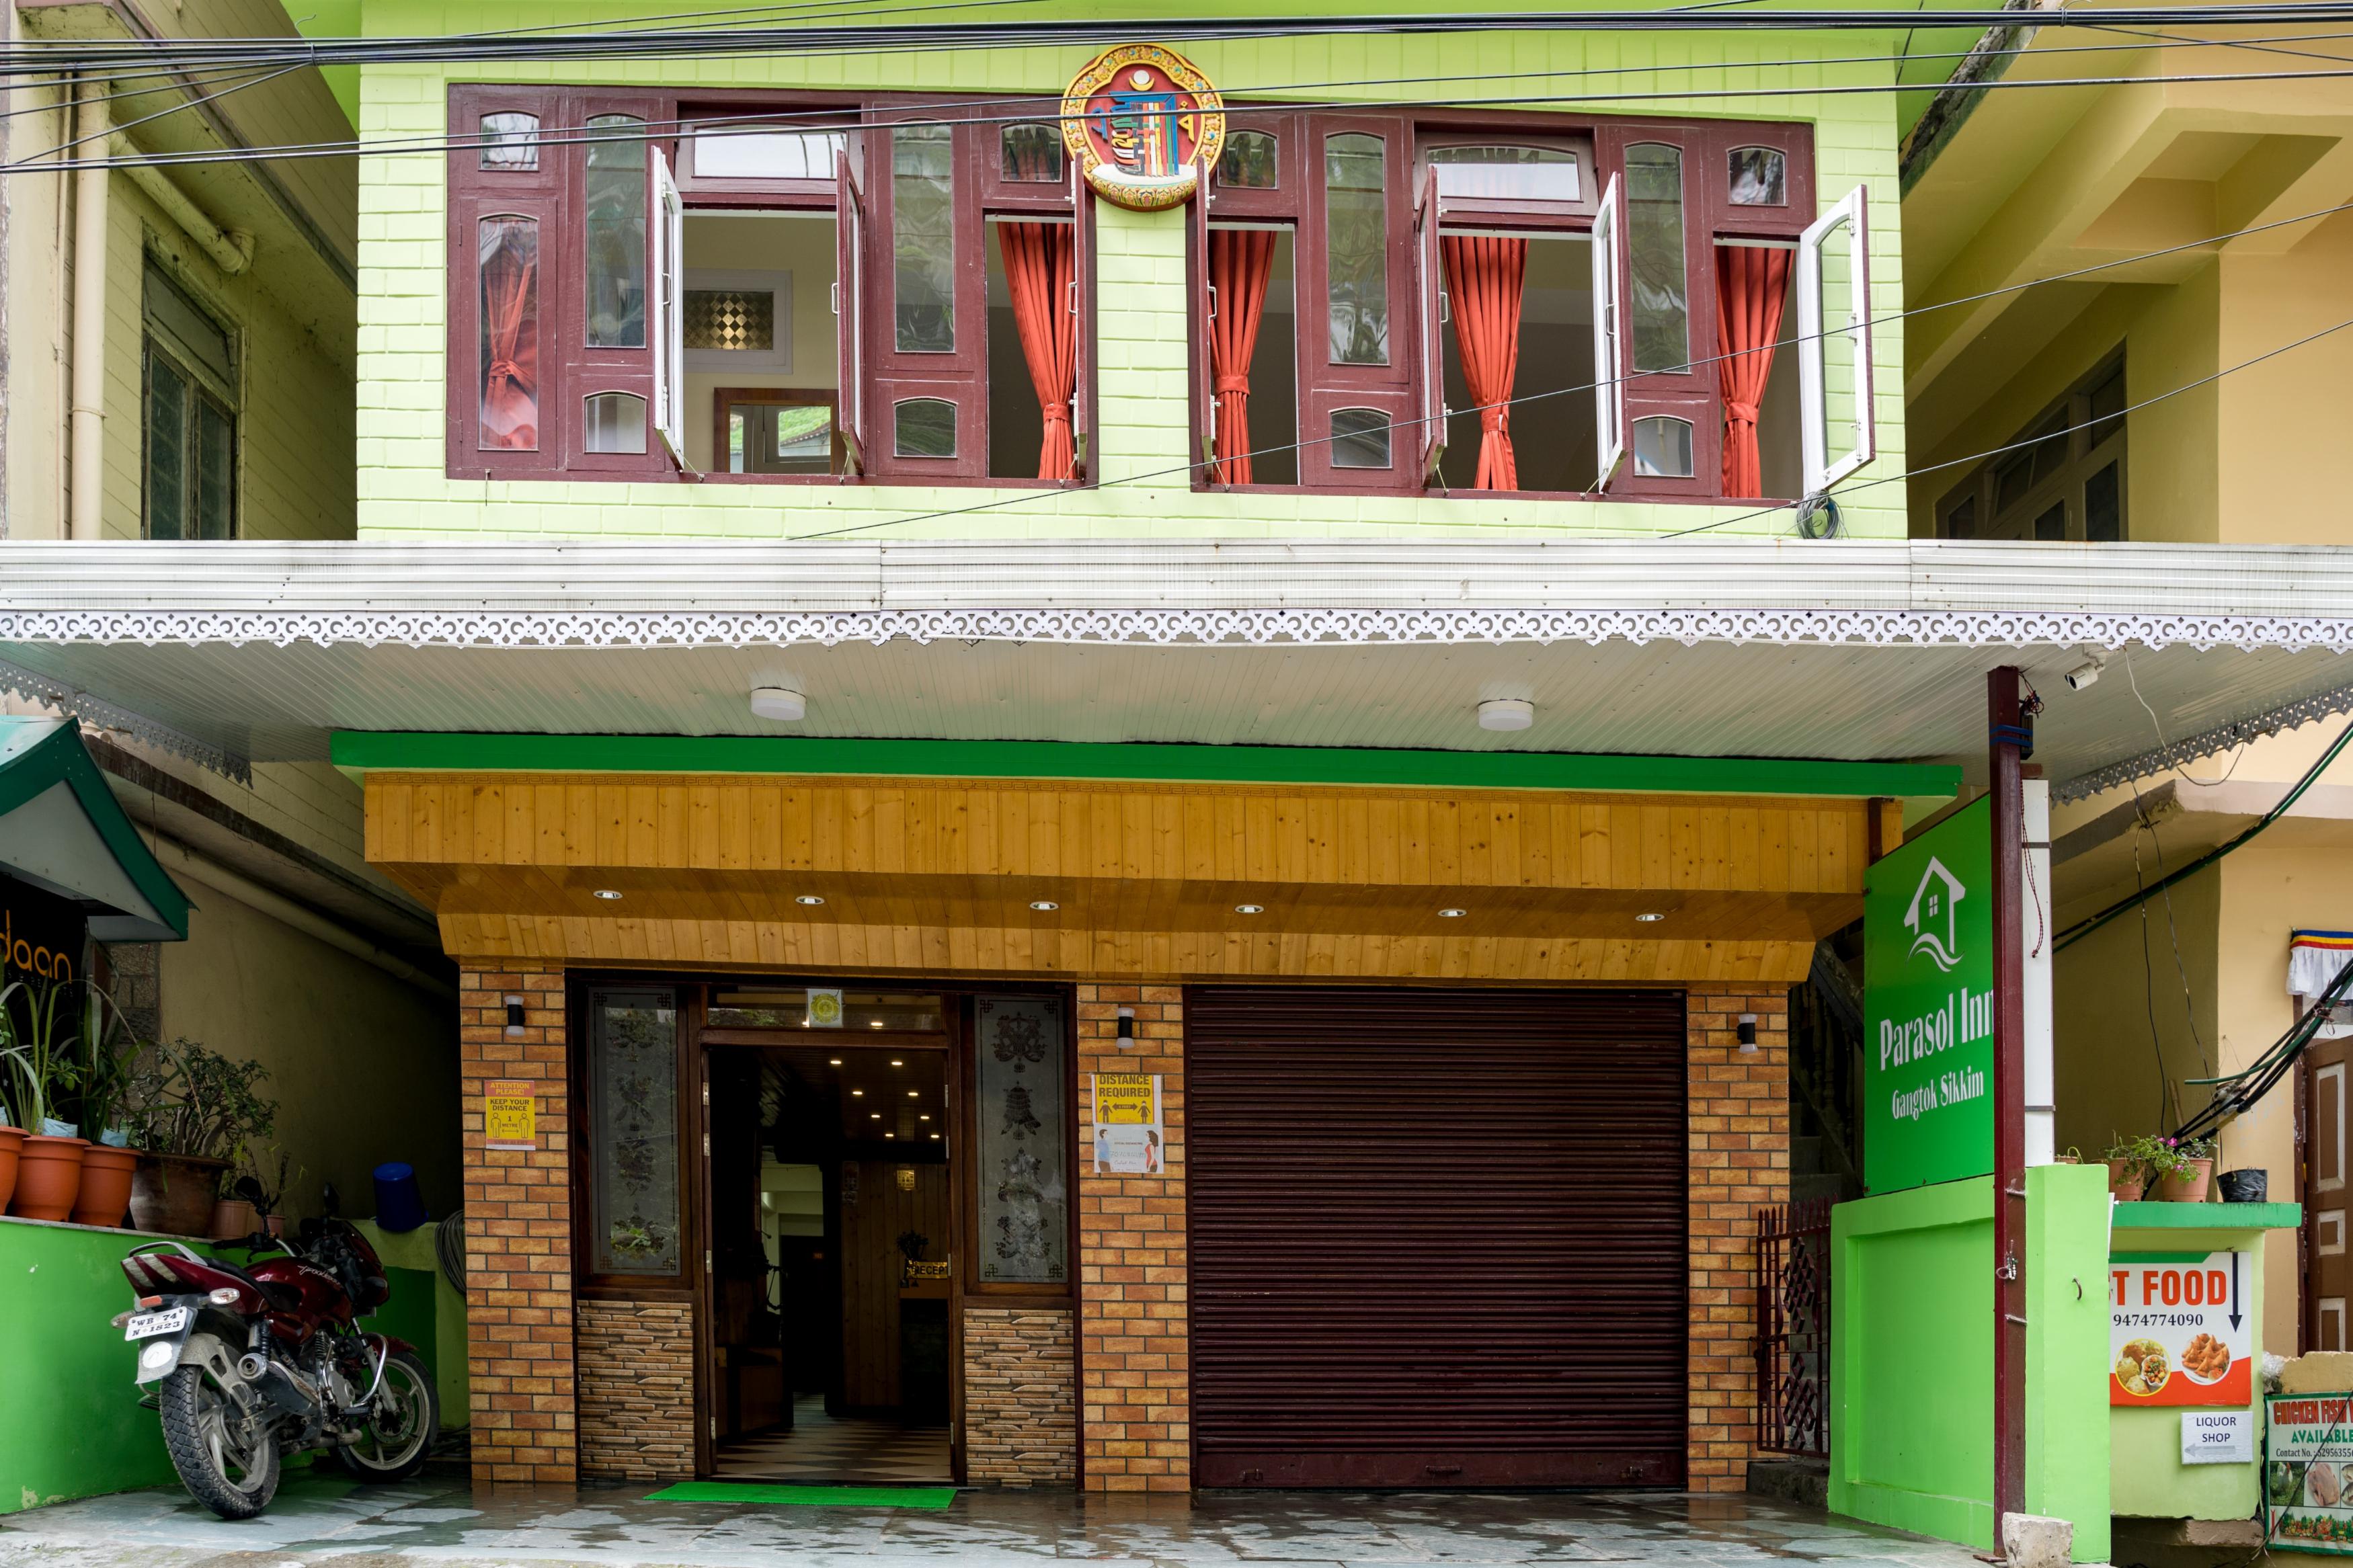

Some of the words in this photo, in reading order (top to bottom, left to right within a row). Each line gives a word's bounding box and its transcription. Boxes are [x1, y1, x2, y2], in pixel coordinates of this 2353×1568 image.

[1880, 993, 1954, 1071] Parasol
[1099, 1075, 1150, 1085] DISTANCE
[1099, 1087, 1150, 1098] REQUIRED
[1892, 1079, 1938, 1121] Gangtok
[1940, 1065, 1984, 1107] Sikkim
[2109, 1270, 2130, 1306] T
[2143, 1270, 2227, 1306] FOOD
[137, 1317, 154, 1327] WB
[163, 1313, 177, 1321] 74
[2113, 1314, 2203, 1326] 9474774090
[149, 1321, 180, 1333] 1823
[2273, 1401, 2319, 1425] CHICKEN
[2321, 1399, 2347, 1423] FISH
[2196, 1417, 2236, 1428] LIQUOR
[2202, 1433, 2231, 1442] SHOP
[2291, 1429, 2353, 1444] AVAILABLE
[2276, 1448, 2300, 1457] Contact
[2301, 1448, 2312, 1457] No.
